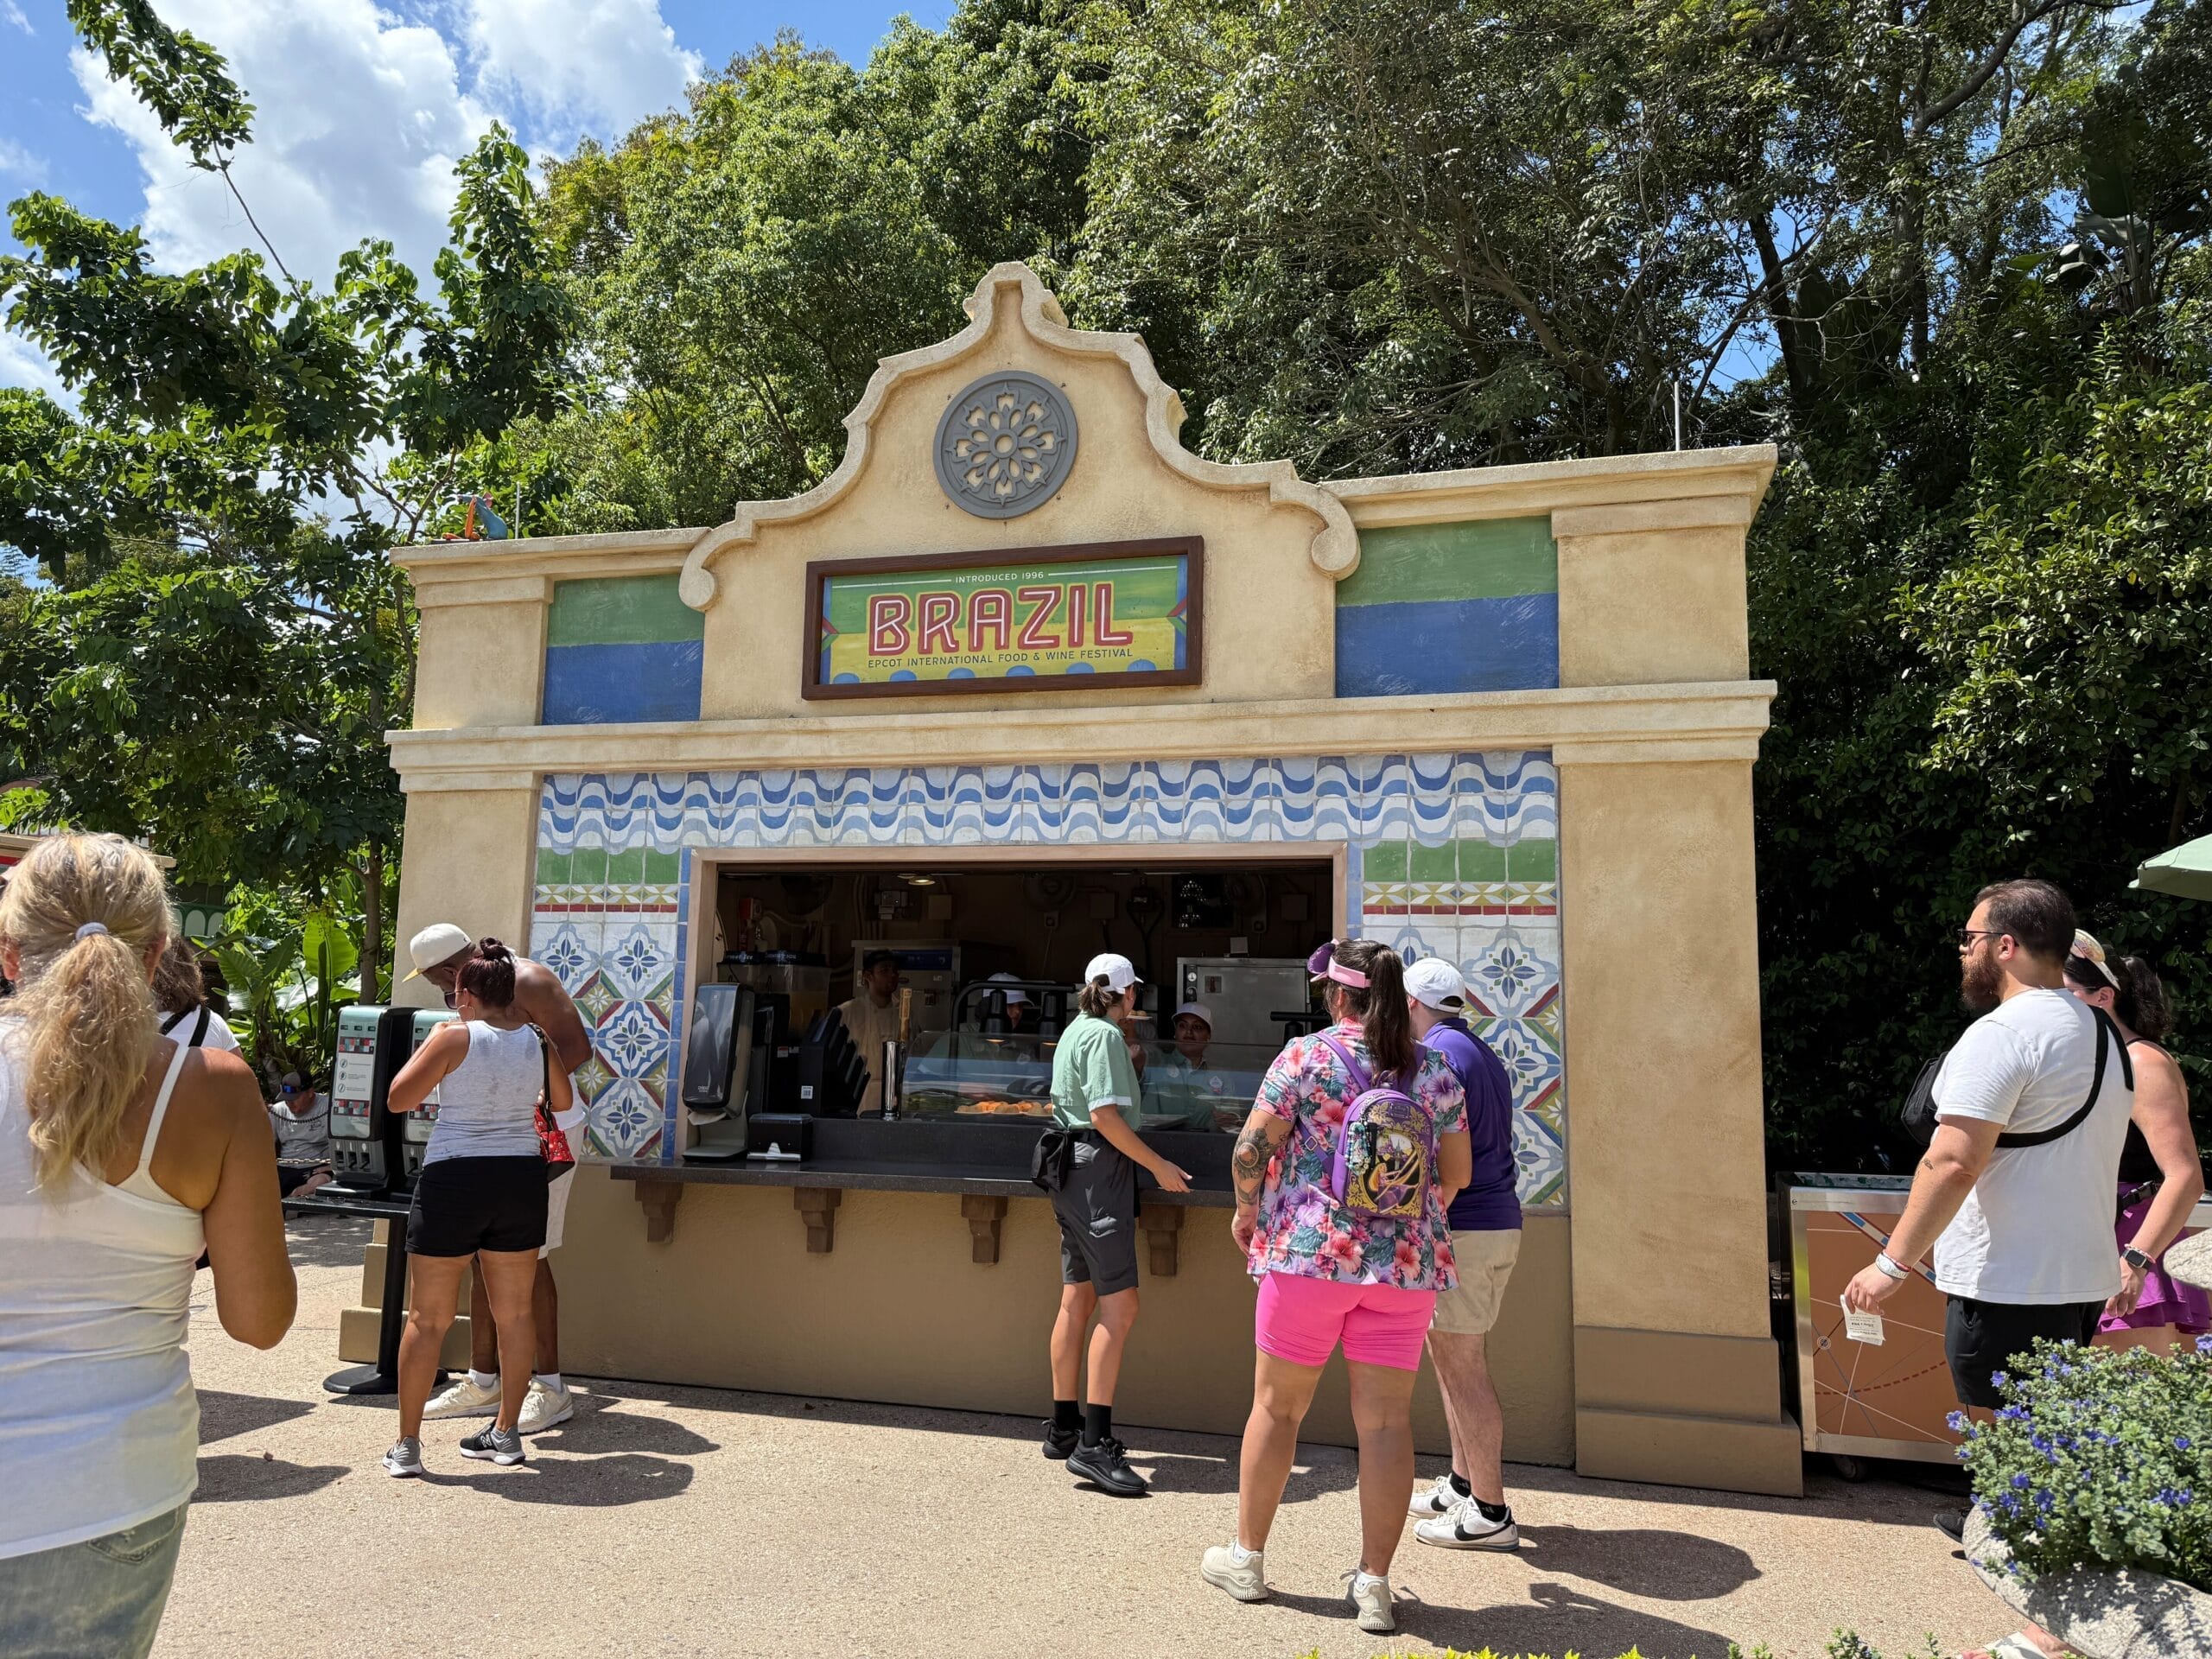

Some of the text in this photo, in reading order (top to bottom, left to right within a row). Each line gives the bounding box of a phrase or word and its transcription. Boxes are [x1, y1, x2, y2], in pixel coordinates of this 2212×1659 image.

[956, 571, 1044, 583] INTRODUCED 1996
[868, 582, 1134, 656] BRAZIL
[868, 648, 1133, 668] EPCOT INTERNATIONAL FOOD & WINE FESTIVAL
